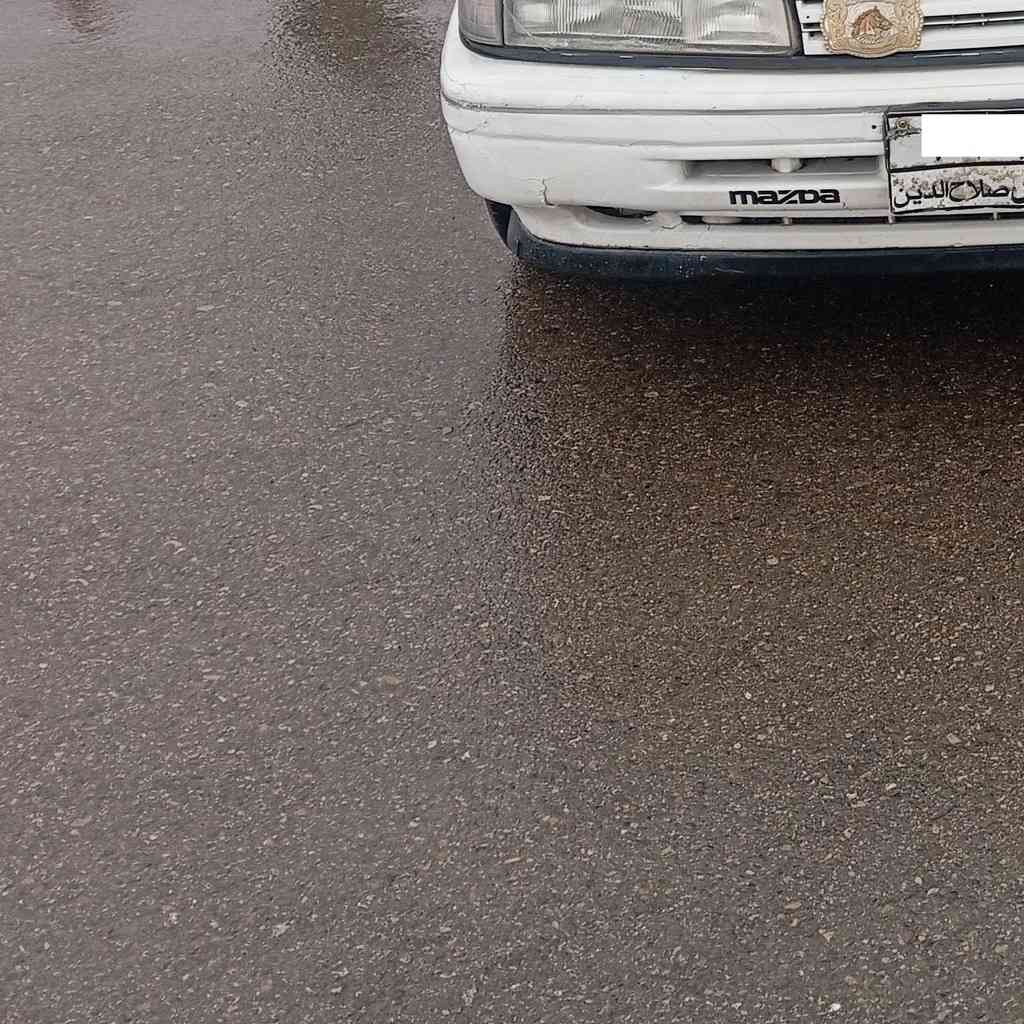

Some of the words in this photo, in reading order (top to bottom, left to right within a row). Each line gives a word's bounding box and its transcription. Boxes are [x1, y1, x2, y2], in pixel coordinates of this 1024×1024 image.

[728, 189, 841, 205] mazda
[894, 177, 949, 208] الدين
[949, 179, 1010, 202] صلاح
